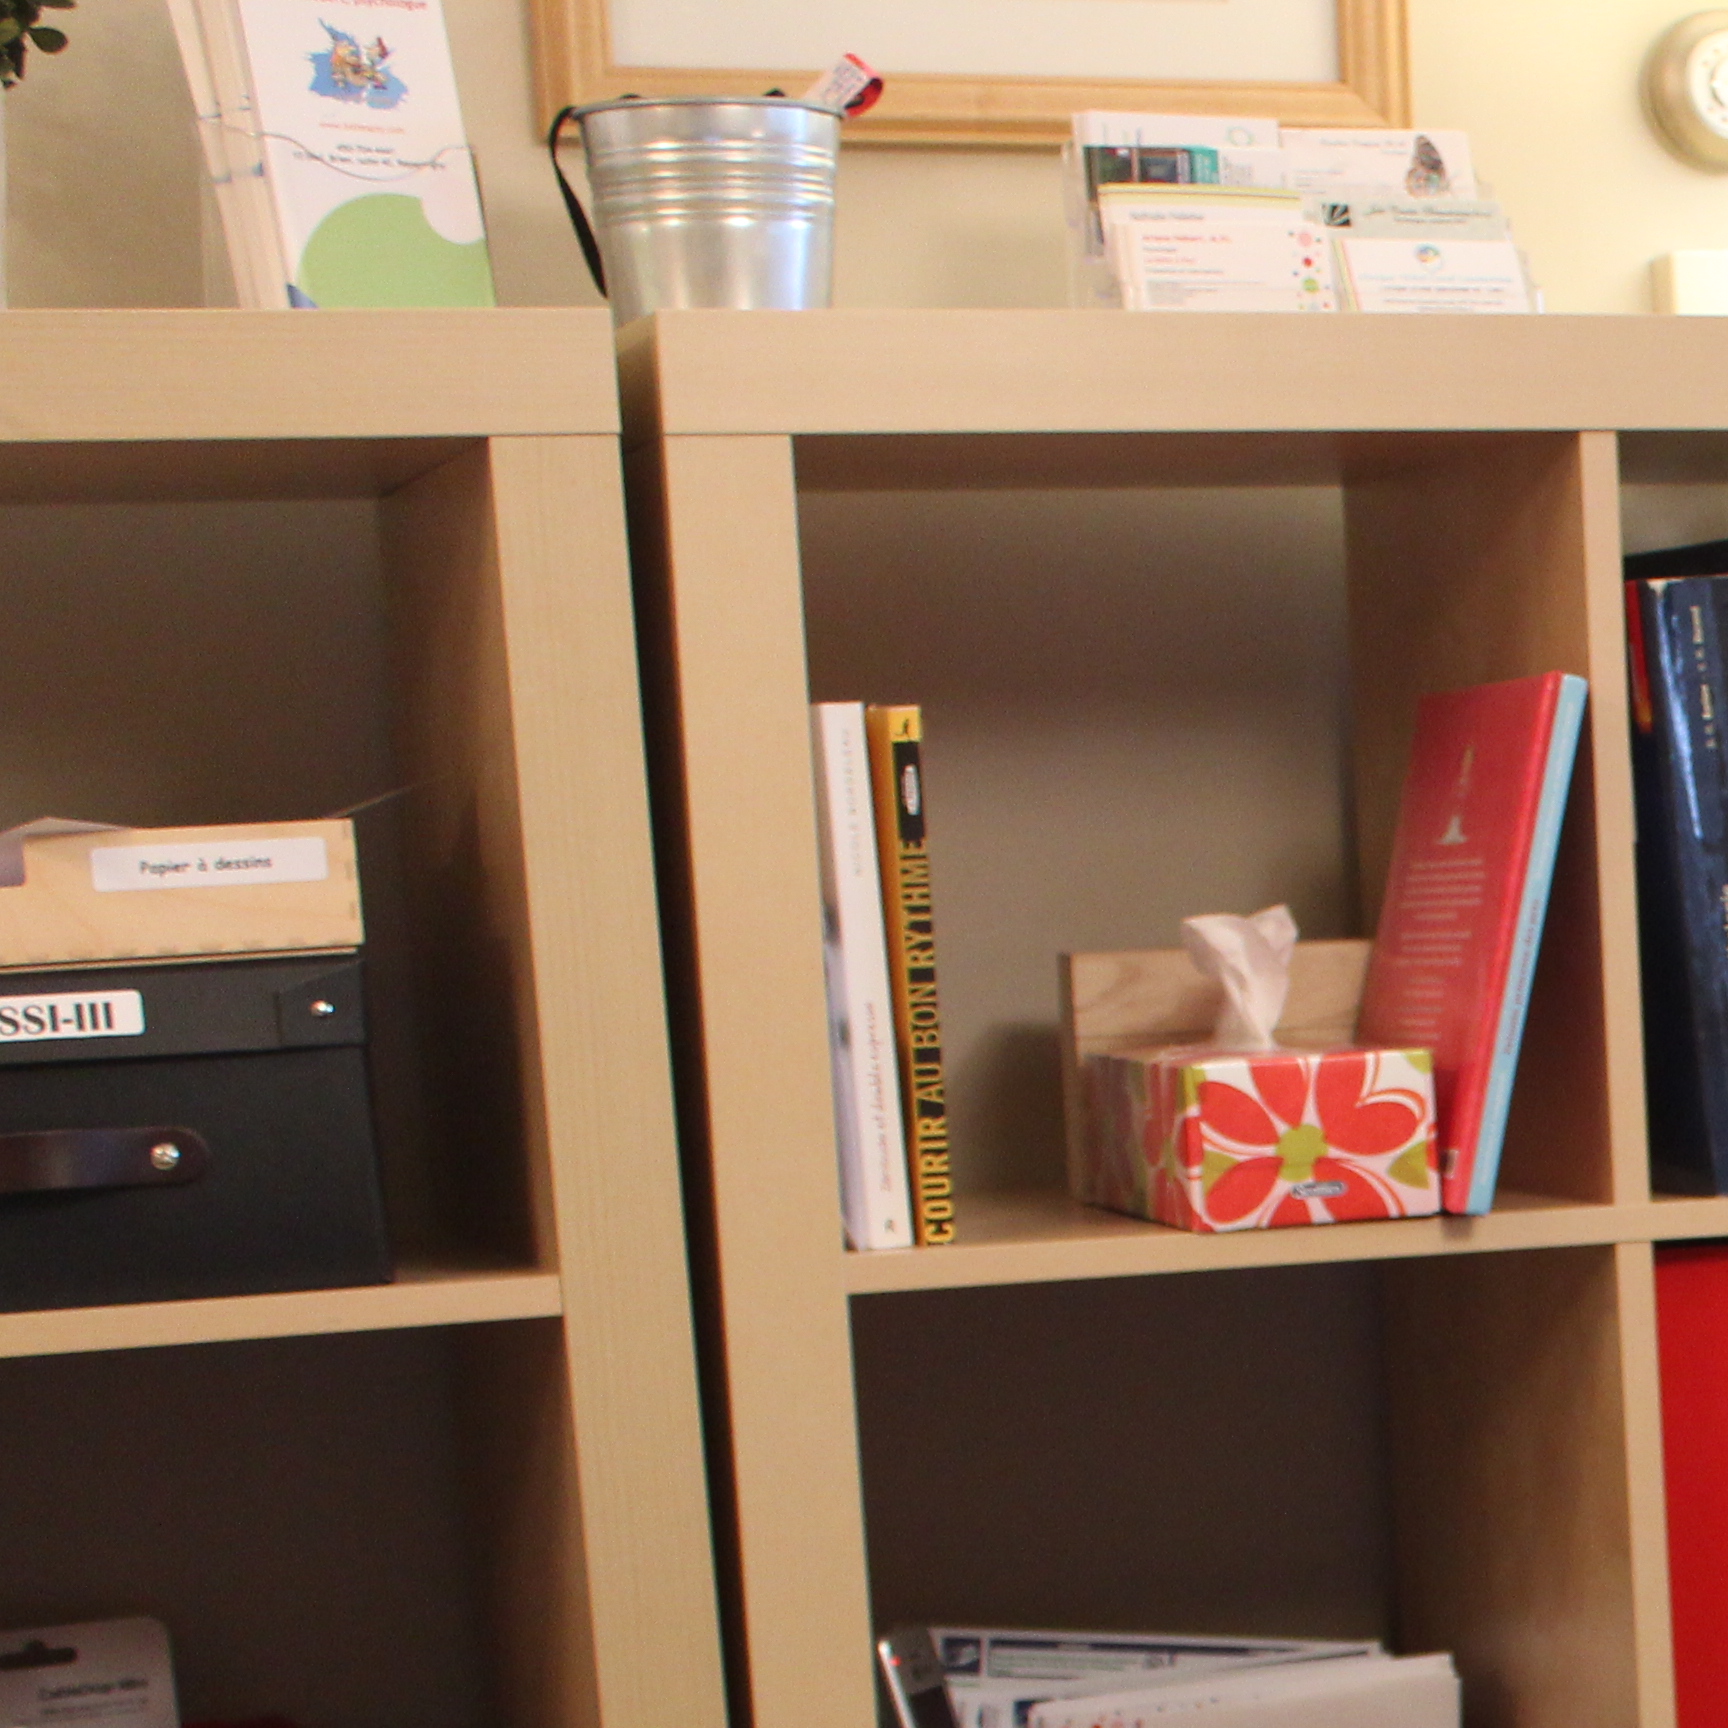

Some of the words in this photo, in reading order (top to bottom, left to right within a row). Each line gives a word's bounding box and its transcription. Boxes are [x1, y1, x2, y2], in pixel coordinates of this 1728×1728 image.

[138, 859, 191, 878] Papier
[196, 857, 208, 872] à
[213, 856, 273, 872] dessins
[899, 838, 936, 968] RYTHME
[908, 981, 942, 1049] BON
[914, 1063, 945, 1102] AU
[917, 1114, 955, 1247] COURIR
